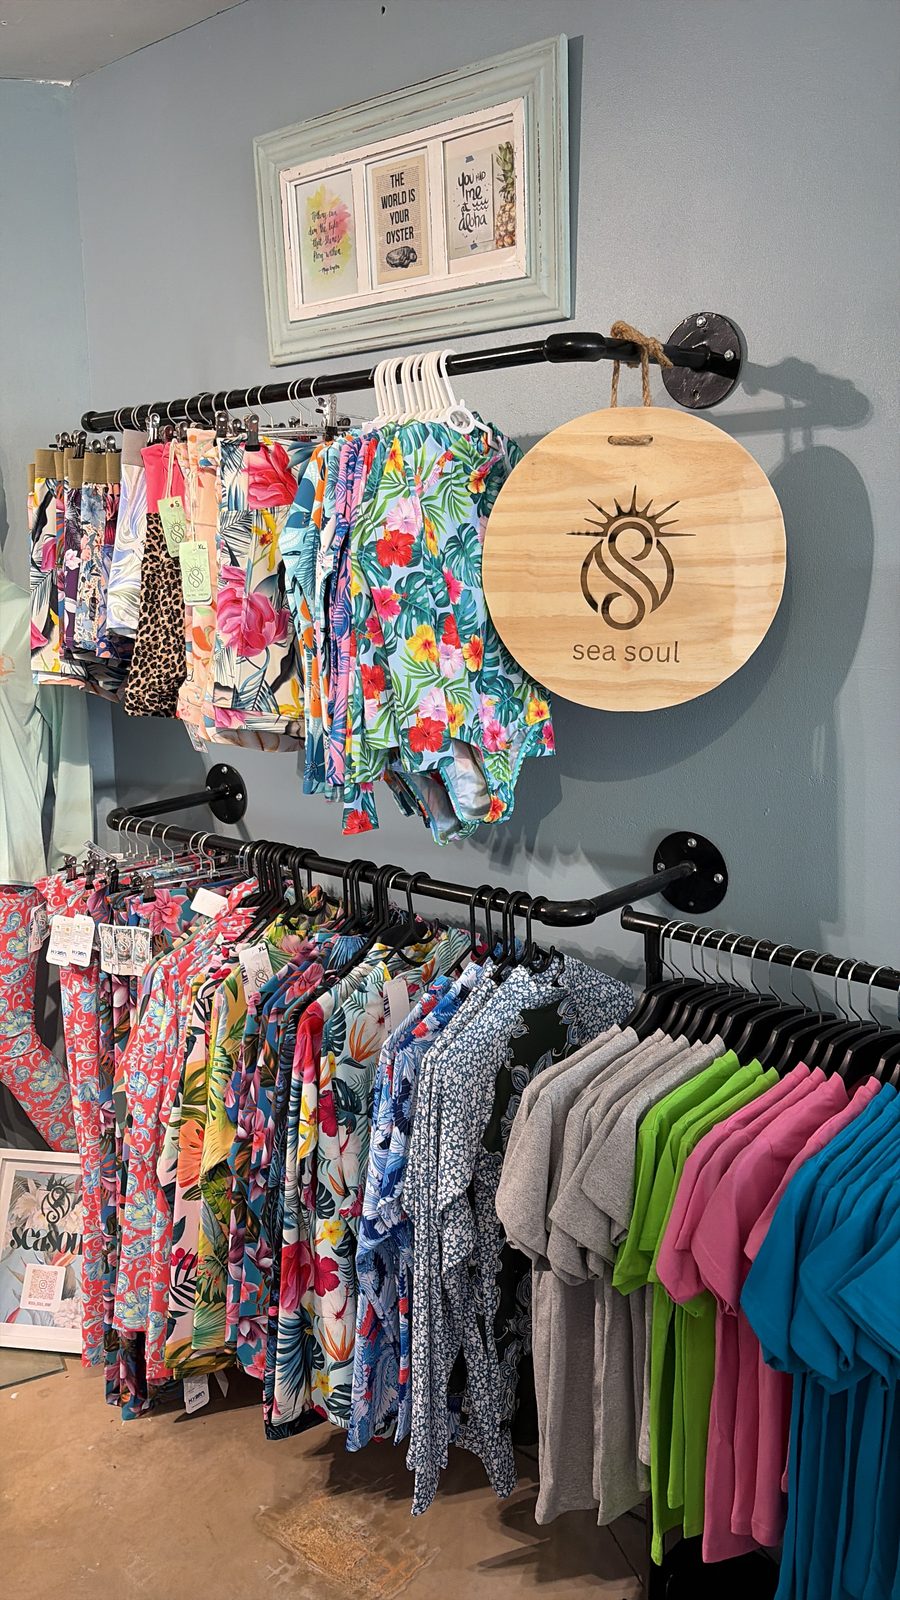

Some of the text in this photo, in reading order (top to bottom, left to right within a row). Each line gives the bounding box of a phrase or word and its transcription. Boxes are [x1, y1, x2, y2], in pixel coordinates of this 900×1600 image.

[390, 172, 405, 188] THE
[381, 188, 416, 209] WORLD IS
[466, 185, 483, 202] me
[390, 208, 410, 226] YOUR
[386, 226, 414, 245] OYSTER
[175, 500, 180, 508] S
[572, 640, 681, 664] sea soul
[10, 1226, 83, 1256] seasou
